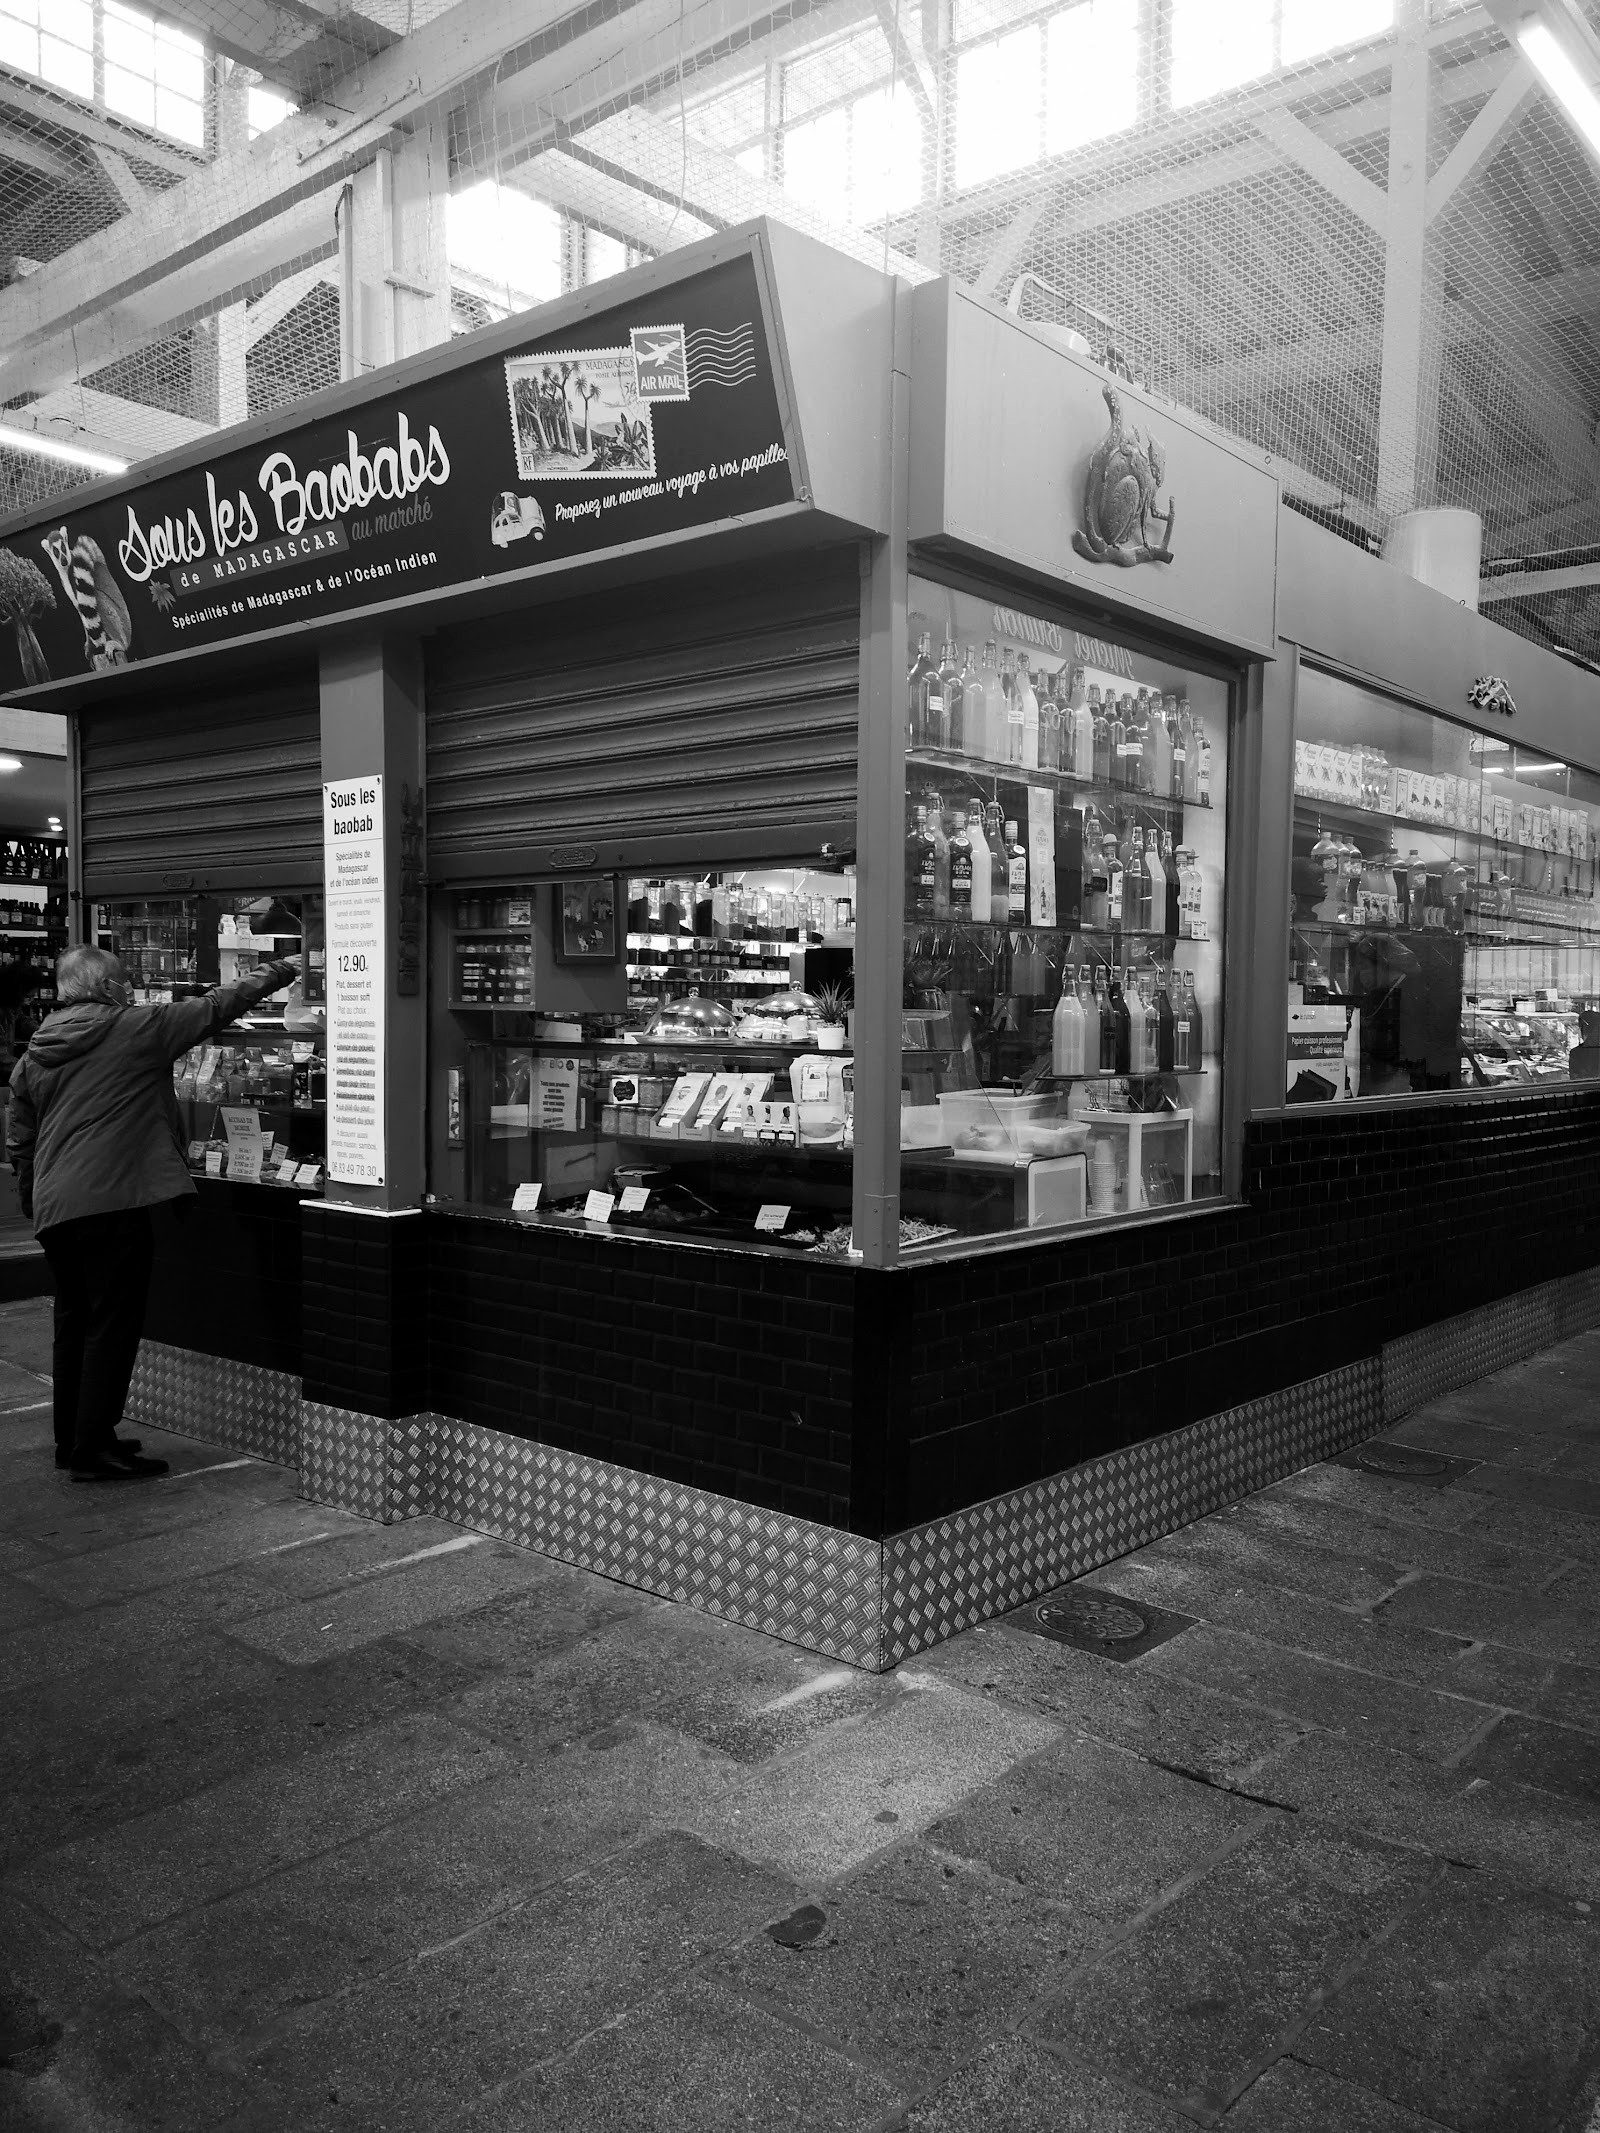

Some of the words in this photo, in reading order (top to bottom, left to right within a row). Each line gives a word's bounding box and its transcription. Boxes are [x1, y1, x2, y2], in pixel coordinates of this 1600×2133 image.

[585, 357, 635, 370] MADAGASCA
[640, 375, 657, 390] AIR
[658, 374, 684, 390] MAIL
[119, 505, 206, 582] Sous
[205, 471, 259, 557] les
[258, 411, 450, 536] Baobabs
[555, 497, 602, 523] Proposez
[602, 495, 618, 509] un
[619, 483, 665, 504] nouveau
[666, 470, 707, 499] voyage
[708, 462, 719, 480] à
[720, 458, 740, 478] vos
[352, 520, 373, 541] au
[374, 495, 434, 535] marché
[180, 571, 201, 588] de
[212, 530, 340, 579] MADAGASCAR
[171, 604, 229, 630] Spécialités
[231, 600, 245, 614] de
[247, 583, 313, 610] Madagascar
[316, 578, 325, 593] &
[327, 574, 343, 589] de
[345, 562, 393, 586] l'Océan
[395, 550, 439, 573] Indien
[330, 791, 356, 809] Sous
[360, 788, 376, 805] les
[333, 814, 373, 836] baobab
[335, 851, 363, 862] Spécialités
[364, 849, 371, 859] de
[338, 862, 369, 875] Madagascar
[330, 879, 335, 888] et
[335, 878, 341, 888] de
[361, 875, 379, 886] indien
[331, 939, 349, 949] Formule
[346, 980, 365, 989] dessert
[366, 981, 372, 989] et
[341, 993, 359, 1002] boisson
[359, 993, 371, 1002] soft
[1291, 1036, 1304, 1046] Papier
[346, 1164, 355, 1175] 49
[356, 1164, 365, 1176] 78
[367, 1165, 376, 1177] 30
